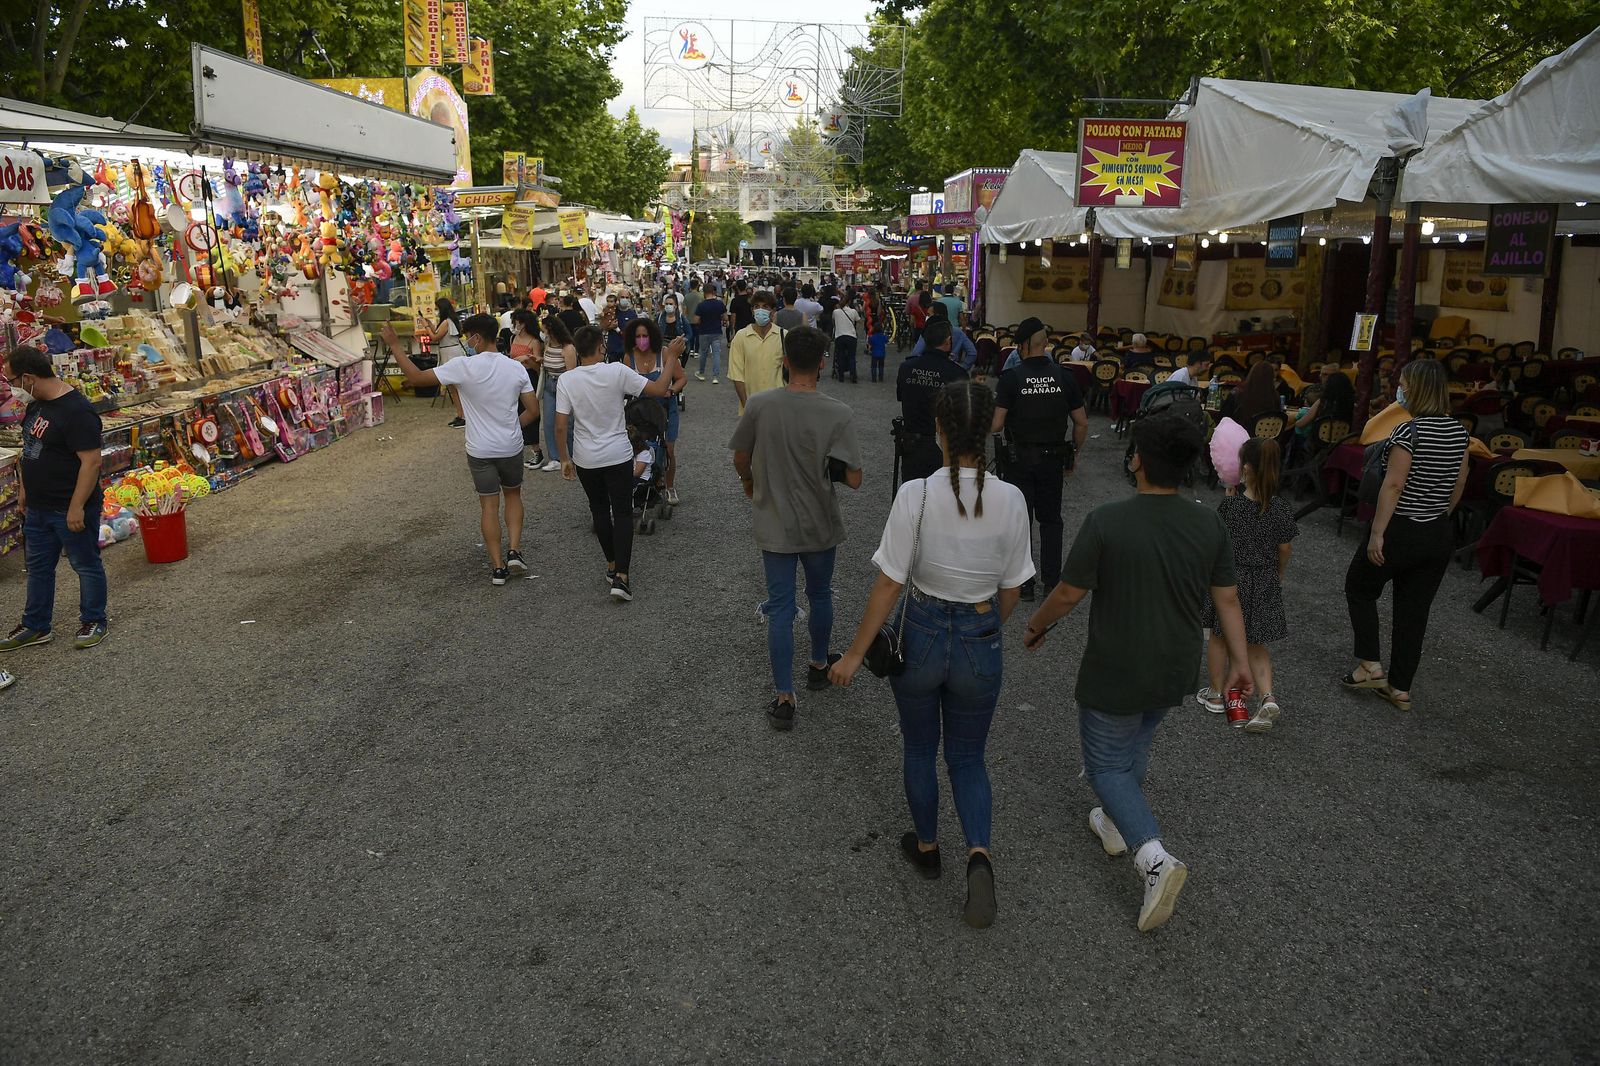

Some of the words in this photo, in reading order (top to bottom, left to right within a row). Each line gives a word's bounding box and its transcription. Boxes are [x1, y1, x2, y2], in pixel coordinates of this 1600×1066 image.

[427, 0, 440, 65] BOCADILLOS
[453, 2, 467, 62] HAMBURGUESAS
[480, 41, 491, 92] PANINI
[1086, 124, 1120, 137] POLLOS
[1122, 125, 1141, 137] CON
[1143, 126, 1182, 138] PATATAS
[1122, 142, 1143, 150] MEDIO
[1101, 163, 1133, 174] PIMIENTO
[1135, 164, 1162, 174] SERVIDO
[1116, 175, 1125, 185] EN
[1126, 176, 1144, 186] MESA
[464, 194, 501, 205] CHIPS
[1494, 210, 1549, 227] CONEJO
[1269, 226, 1298, 240] EXQUISITOS
[1510, 232, 1527, 247] AL
[1270, 246, 1294, 259] CHOPITOS
[1490, 250, 1544, 266] AJILLO
[912, 368, 941, 378] POLICIA
[905, 377, 945, 390] GRANADA
[1026, 376, 1055, 384] POLICIA
[1021, 386, 1062, 395] GRANADA
